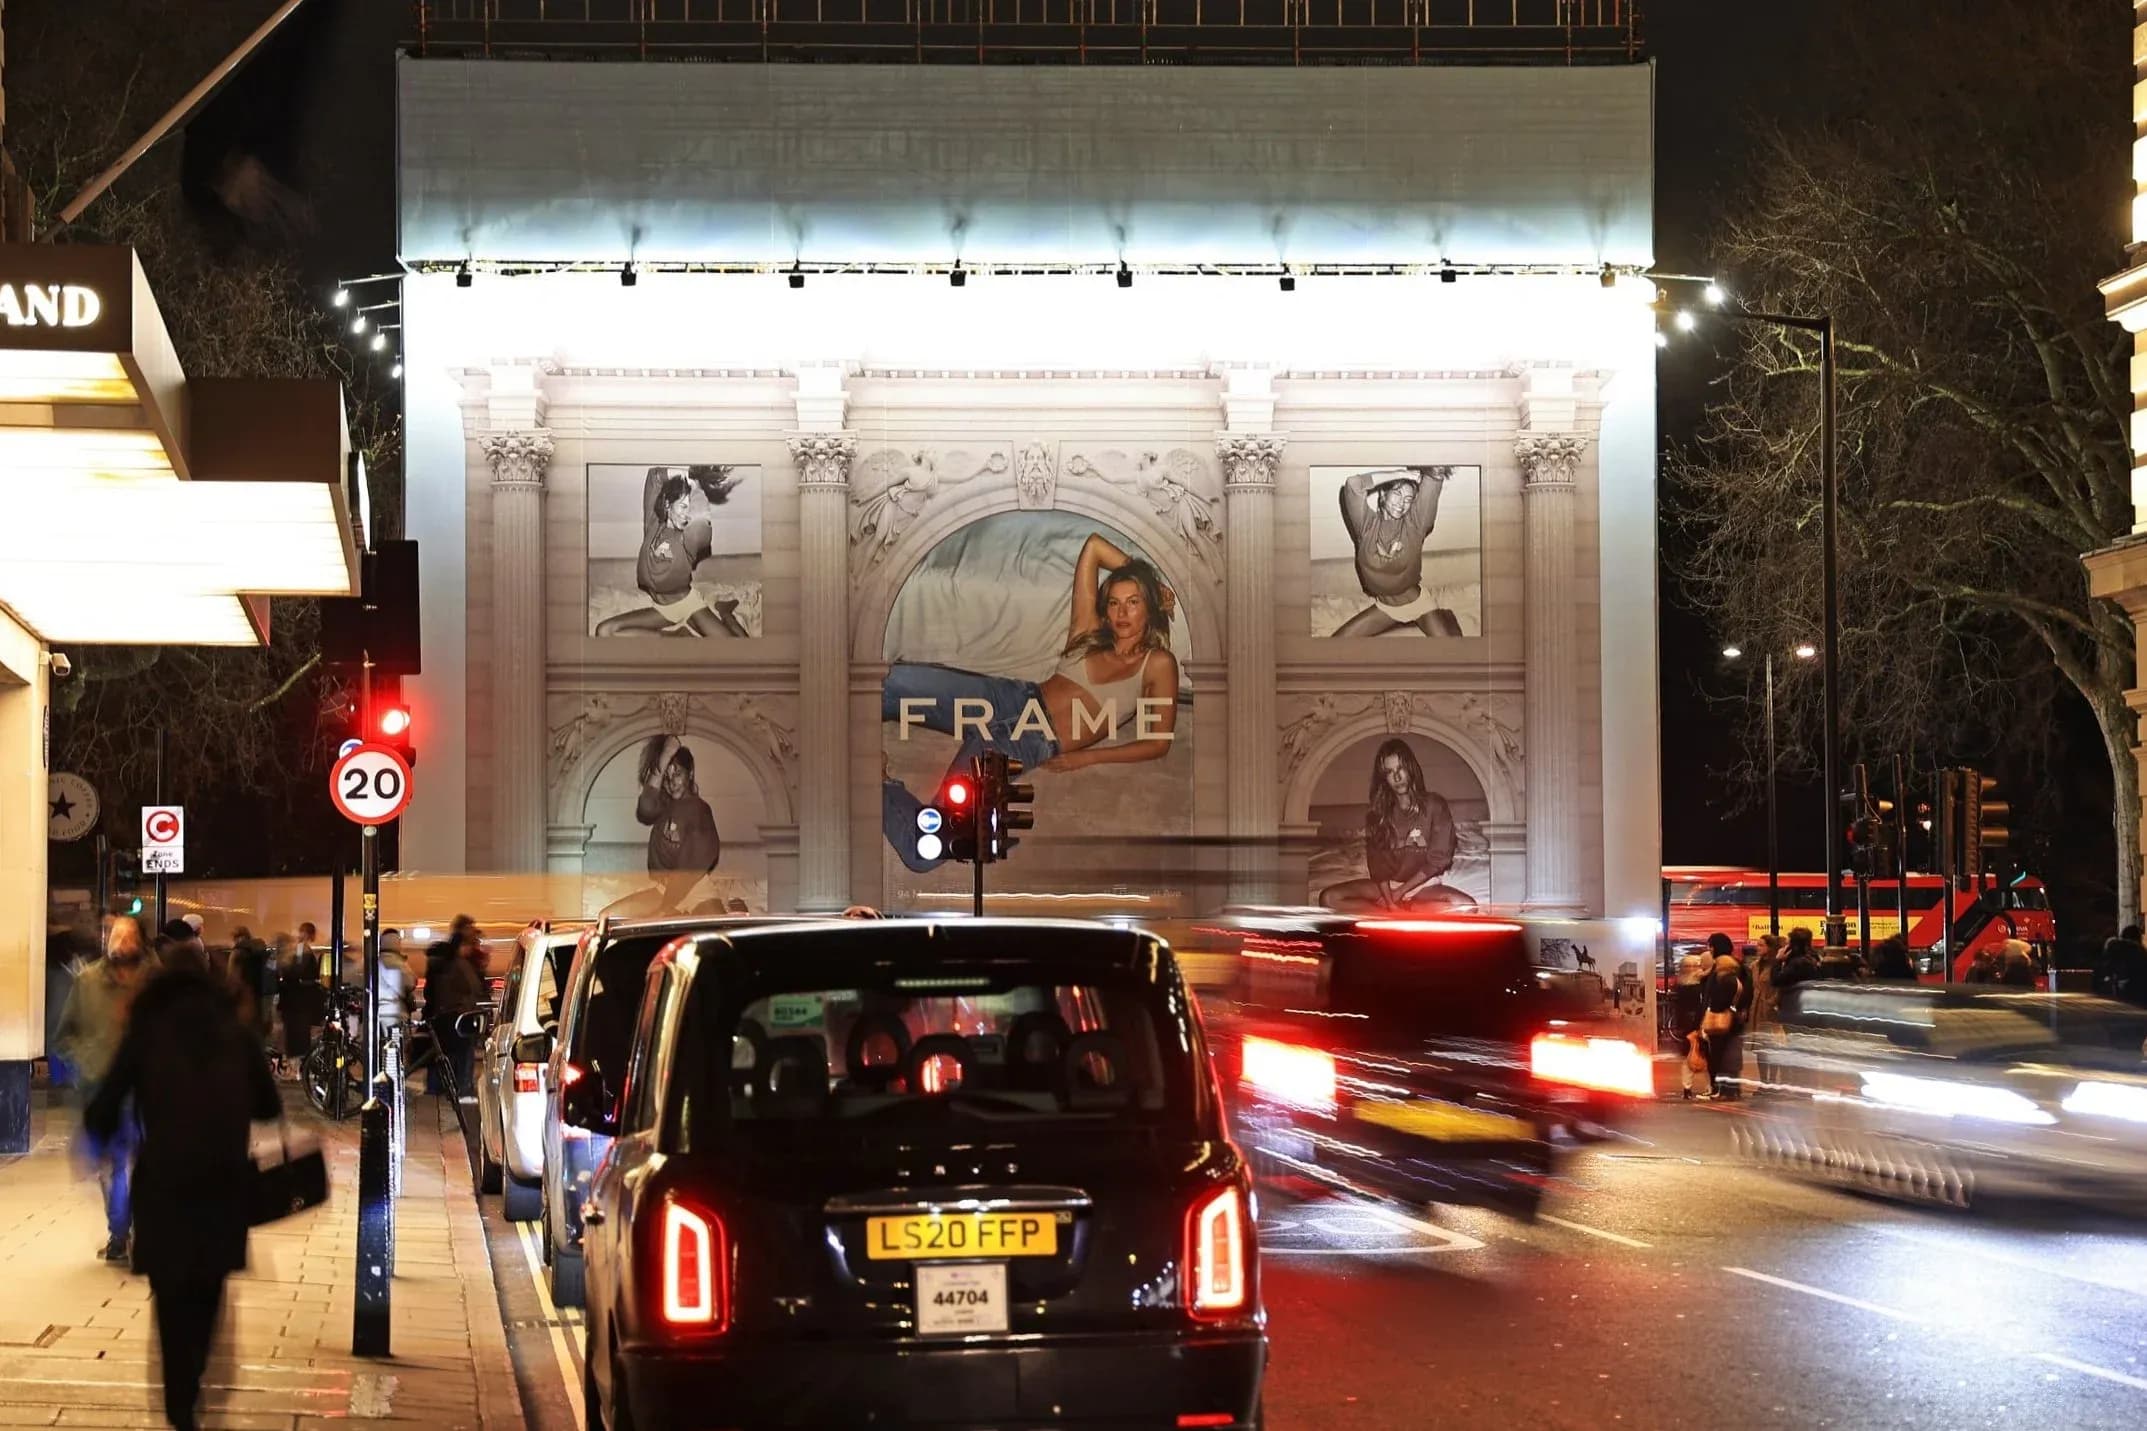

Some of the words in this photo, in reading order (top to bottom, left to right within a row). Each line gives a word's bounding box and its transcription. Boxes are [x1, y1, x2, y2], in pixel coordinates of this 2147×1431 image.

[0, 283, 100, 327] AND
[900, 697, 1174, 741] FRAME
[344, 768, 400, 799] 20
[146, 860, 179, 869] ENDS
[881, 1220, 967, 1250] LS20
[978, 1220, 1040, 1247] FFP
[933, 1289, 988, 1306] 44704
